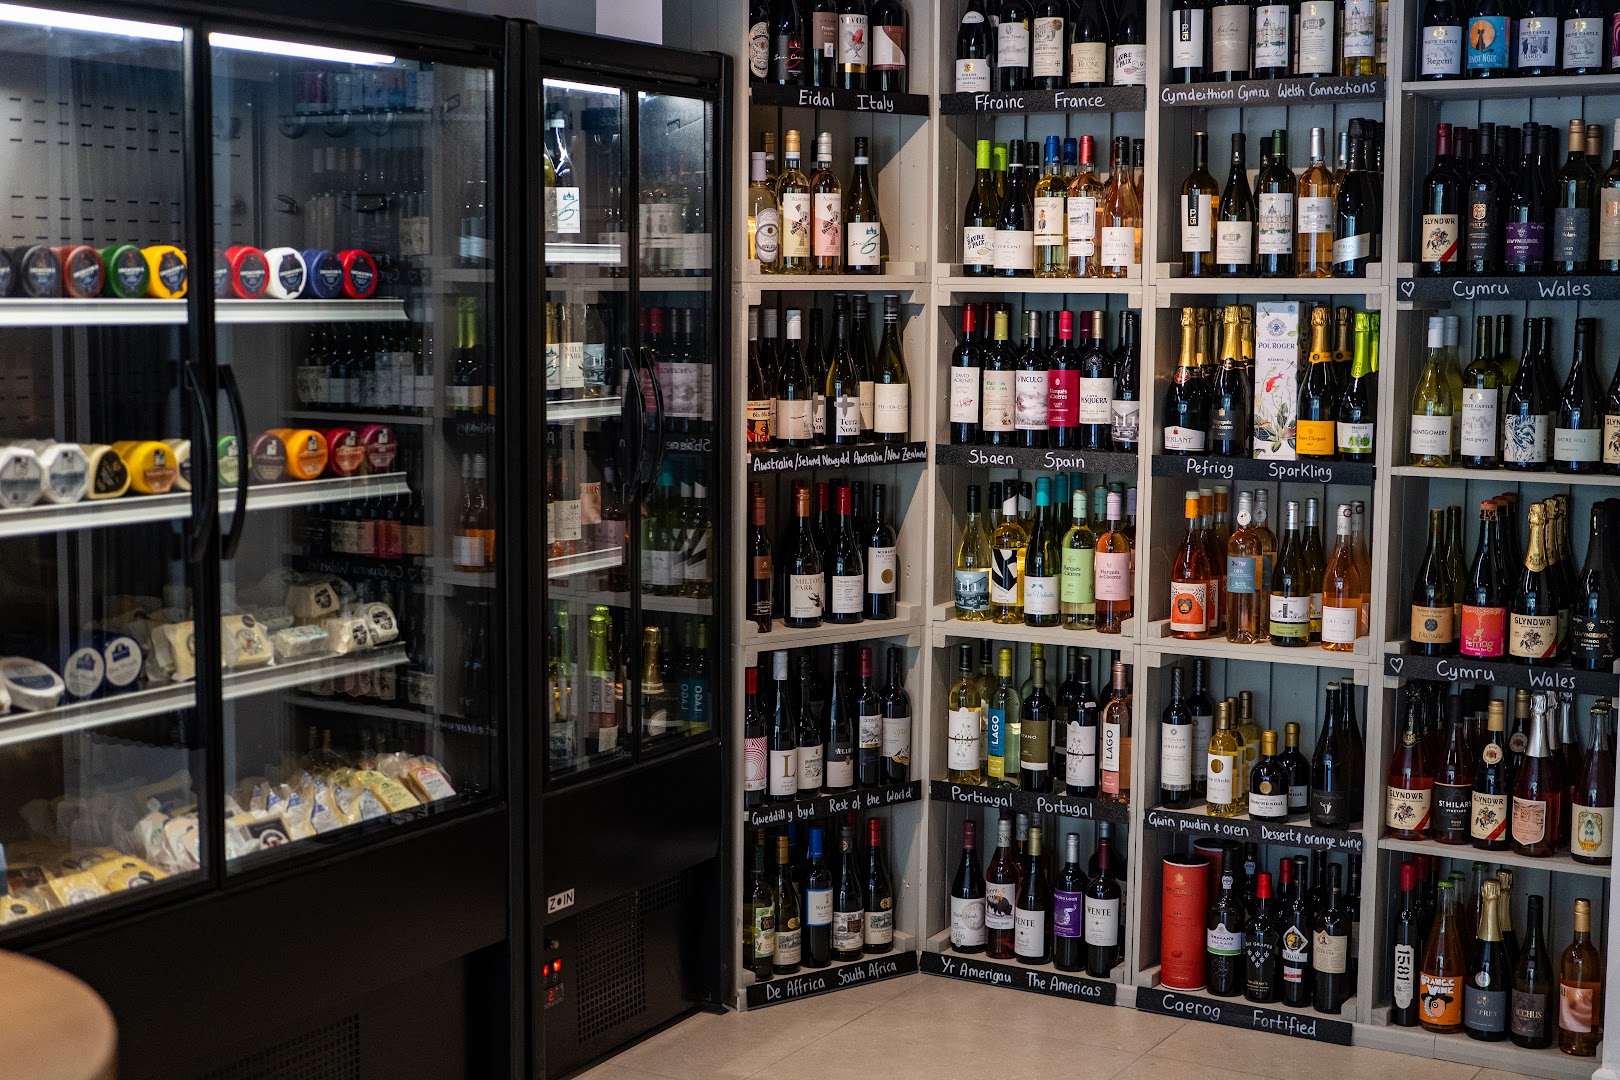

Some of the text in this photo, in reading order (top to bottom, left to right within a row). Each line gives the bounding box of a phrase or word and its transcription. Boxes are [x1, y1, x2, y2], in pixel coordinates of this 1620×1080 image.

[1427, 57, 1453, 66] Regent
[1482, 54, 1496, 63] NOIR
[798, 89, 894, 112] Eidal Italy
[975, 92, 1106, 111] Ffrainc France
[1161, 81, 1377, 104] Cymdeithion Cymru Welsh Connections
[1424, 217, 1456, 225] GLYNDWR
[1452, 280, 1592, 300] Cymru Wales
[1272, 342, 1295, 350] ROGER
[901, 446, 927, 461] Zealand
[968, 449, 1086, 469] Sbaen Spain
[1186, 458, 1333, 483] Pefriog Sparkling
[1514, 616, 1552, 627] GLYNDWR
[1437, 659, 1576, 690] Cymru Wales
[990, 715, 1000, 745] LAGO
[1105, 729, 1114, 760] LAGO
[797, 803, 815, 820] byd
[829, 797, 849, 813] Rest
[852, 795, 862, 811] of
[866, 791, 880, 807] the
[886, 786, 913, 802] World
[951, 785, 1093, 818] Portiwgal Portugal
[1389, 789, 1424, 800] GLYNDWR
[1149, 811, 1175, 828] Gwin
[1180, 816, 1211, 832] pwdin
[1223, 823, 1250, 837] oren
[1262, 825, 1296, 841] Dessert
[1304, 836, 1337, 849] orange
[1339, 838, 1363, 851] wine
[1087, 905, 1112, 916] WENTE
[766, 961, 897, 1000] De Affrica South Africa
[940, 956, 1102, 997] Yr Amerigau The Americas
[1421, 975, 1456, 987] ORANGE
[1427, 985, 1454, 996] WINE
[1162, 994, 1317, 1038] Caerog Fortified
[1515, 1008, 1543, 1018] ACCHUS
